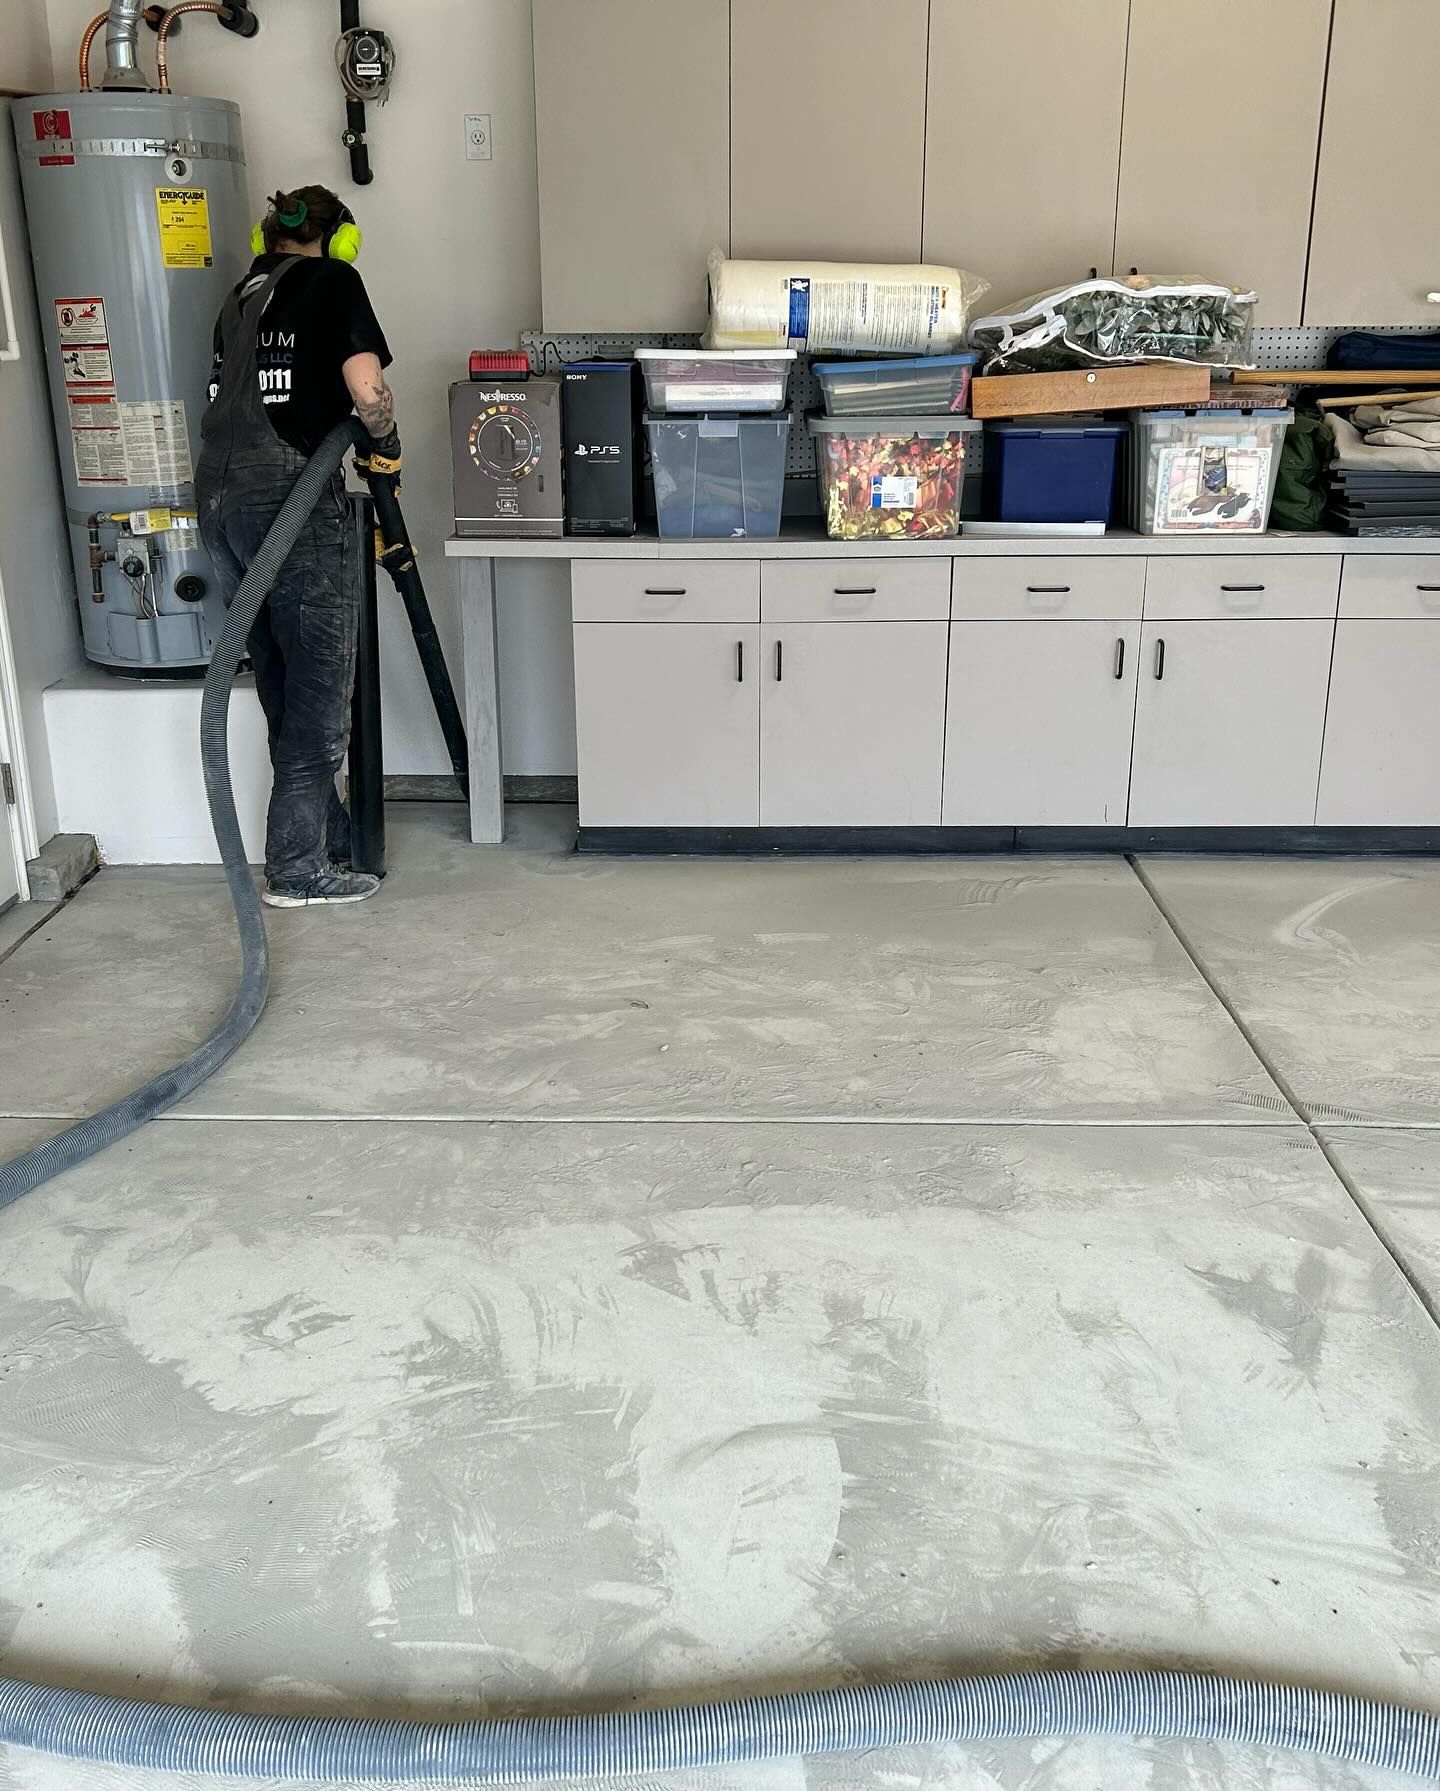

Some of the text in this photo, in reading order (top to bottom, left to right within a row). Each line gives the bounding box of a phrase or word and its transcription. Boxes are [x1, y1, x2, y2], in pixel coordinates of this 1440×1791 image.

[159, 191, 205, 200] ENERGYGUIDE
[479, 389, 527, 402] NESPRESSO
[590, 445, 620, 455] PS5
